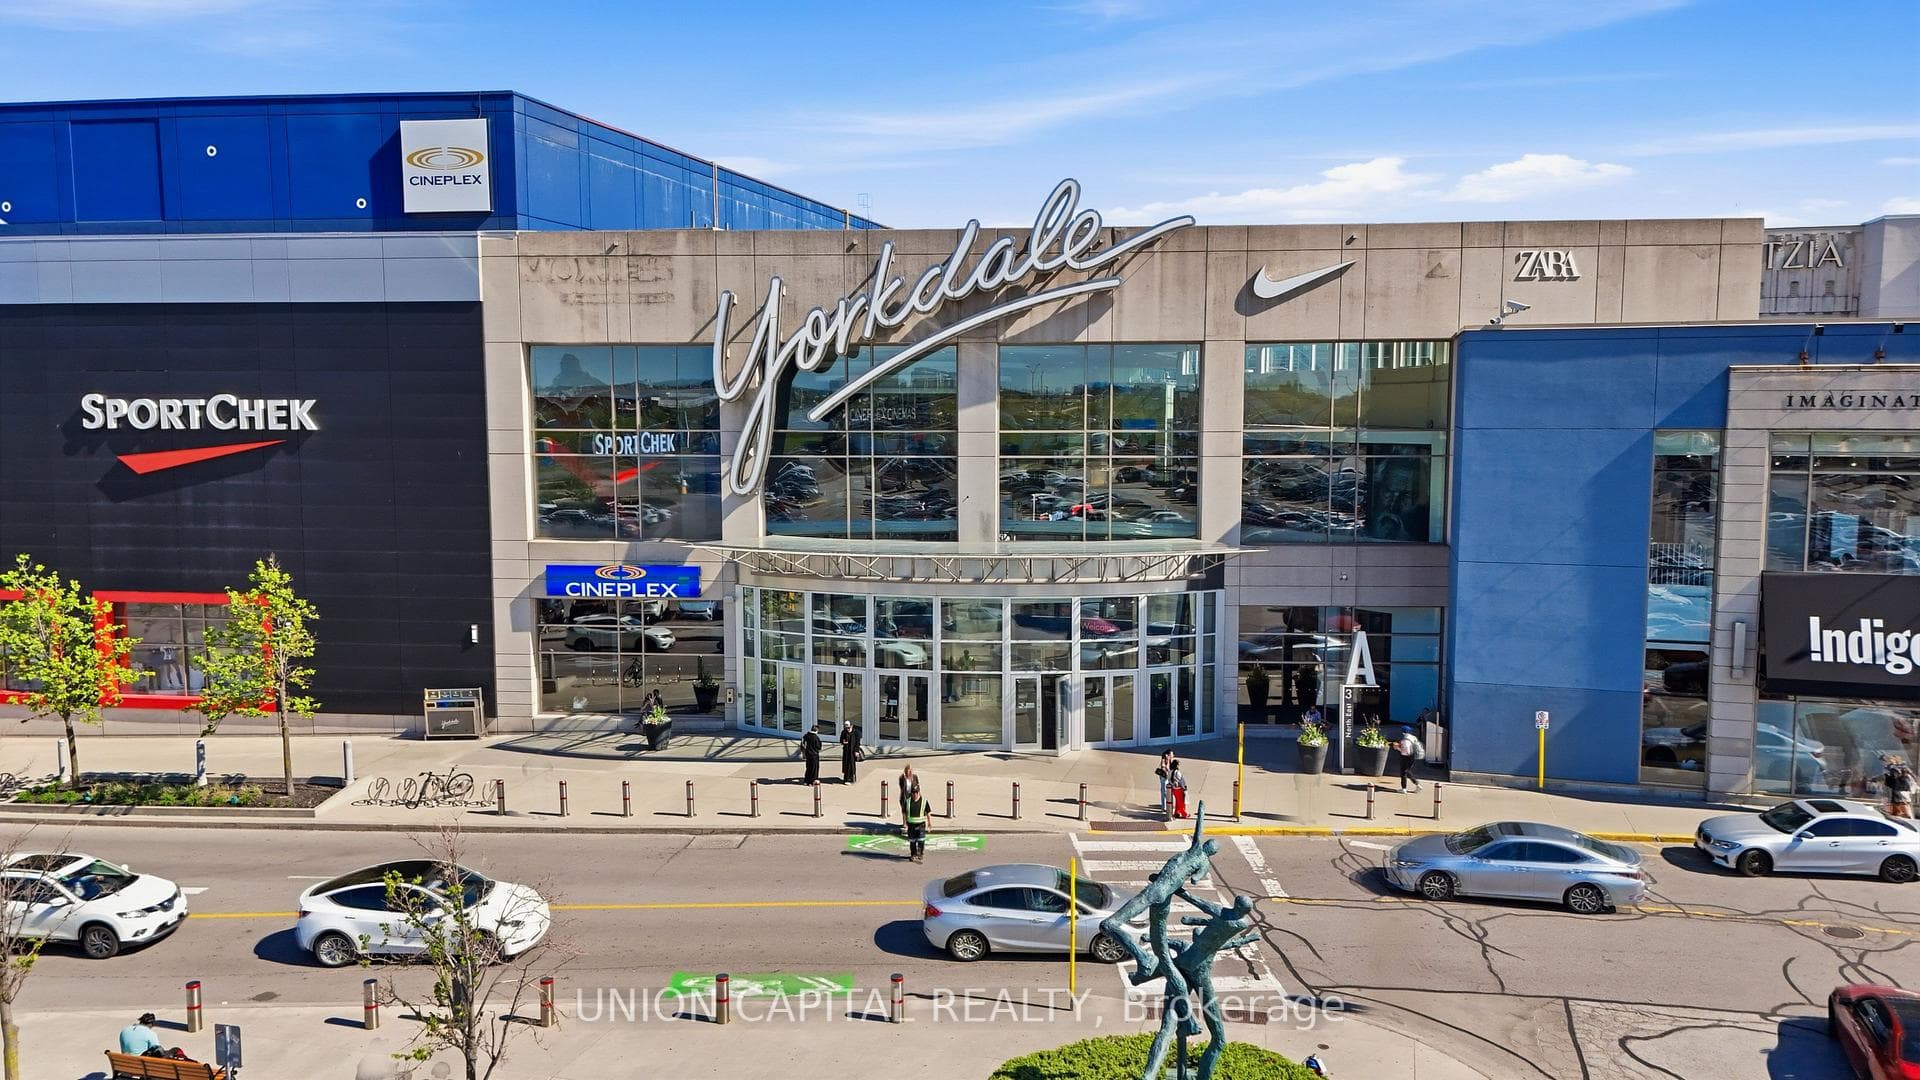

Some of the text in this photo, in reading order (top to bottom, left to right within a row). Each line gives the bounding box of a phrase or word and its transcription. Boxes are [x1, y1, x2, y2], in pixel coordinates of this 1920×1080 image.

[409, 174, 482, 186] CINEPLEX
[1518, 249, 1582, 278] ZARA
[565, 582, 679, 598] CINEPLEX
[1346, 631, 1376, 685] A
[1345, 689, 1352, 699] 3
